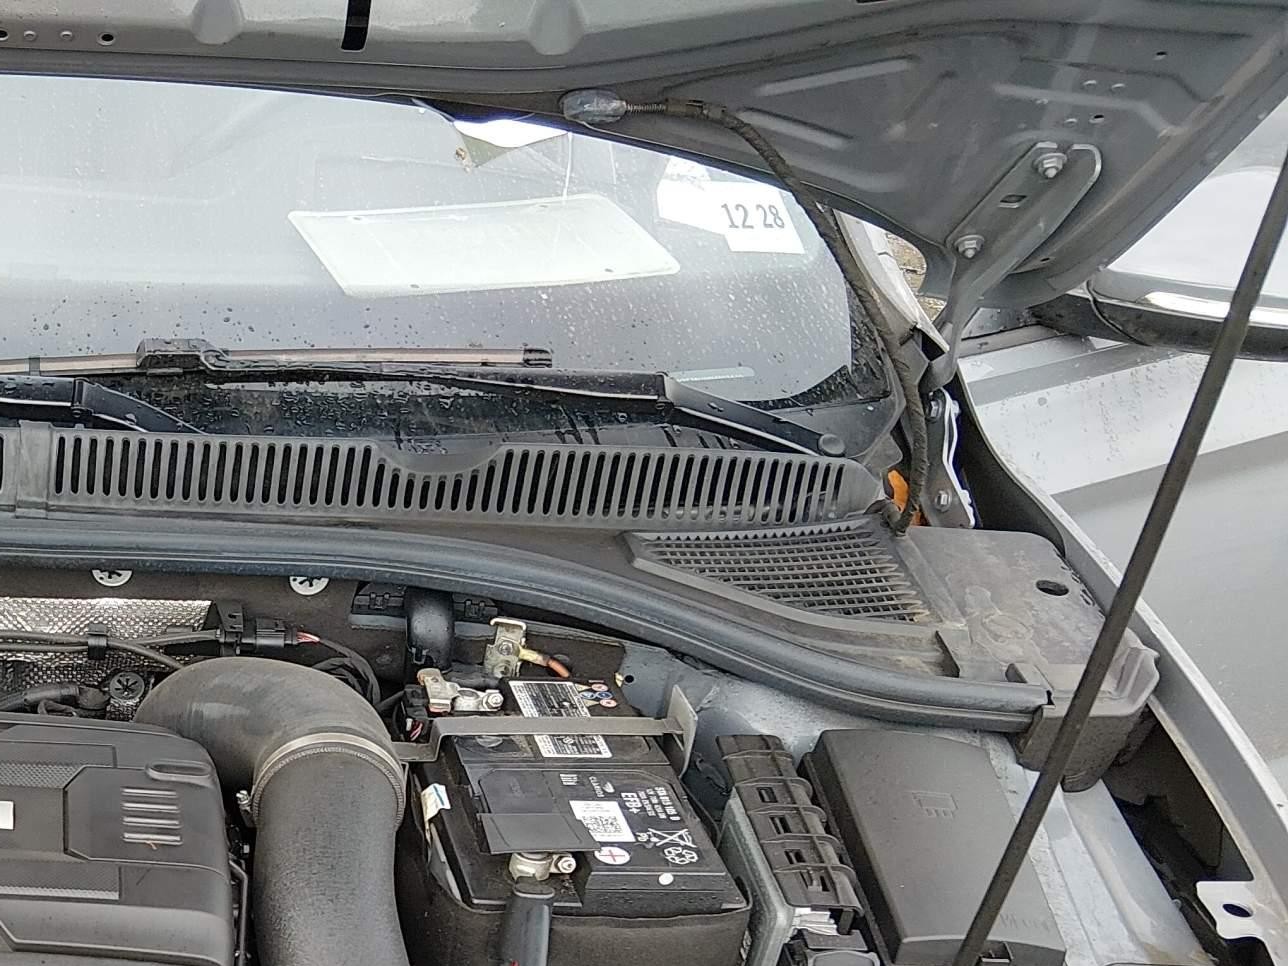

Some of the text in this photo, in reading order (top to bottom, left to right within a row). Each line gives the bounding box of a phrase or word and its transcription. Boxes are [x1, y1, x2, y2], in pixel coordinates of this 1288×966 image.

[721, 202, 786, 229] 12 28
[621, 792, 642, 814] EFB+
